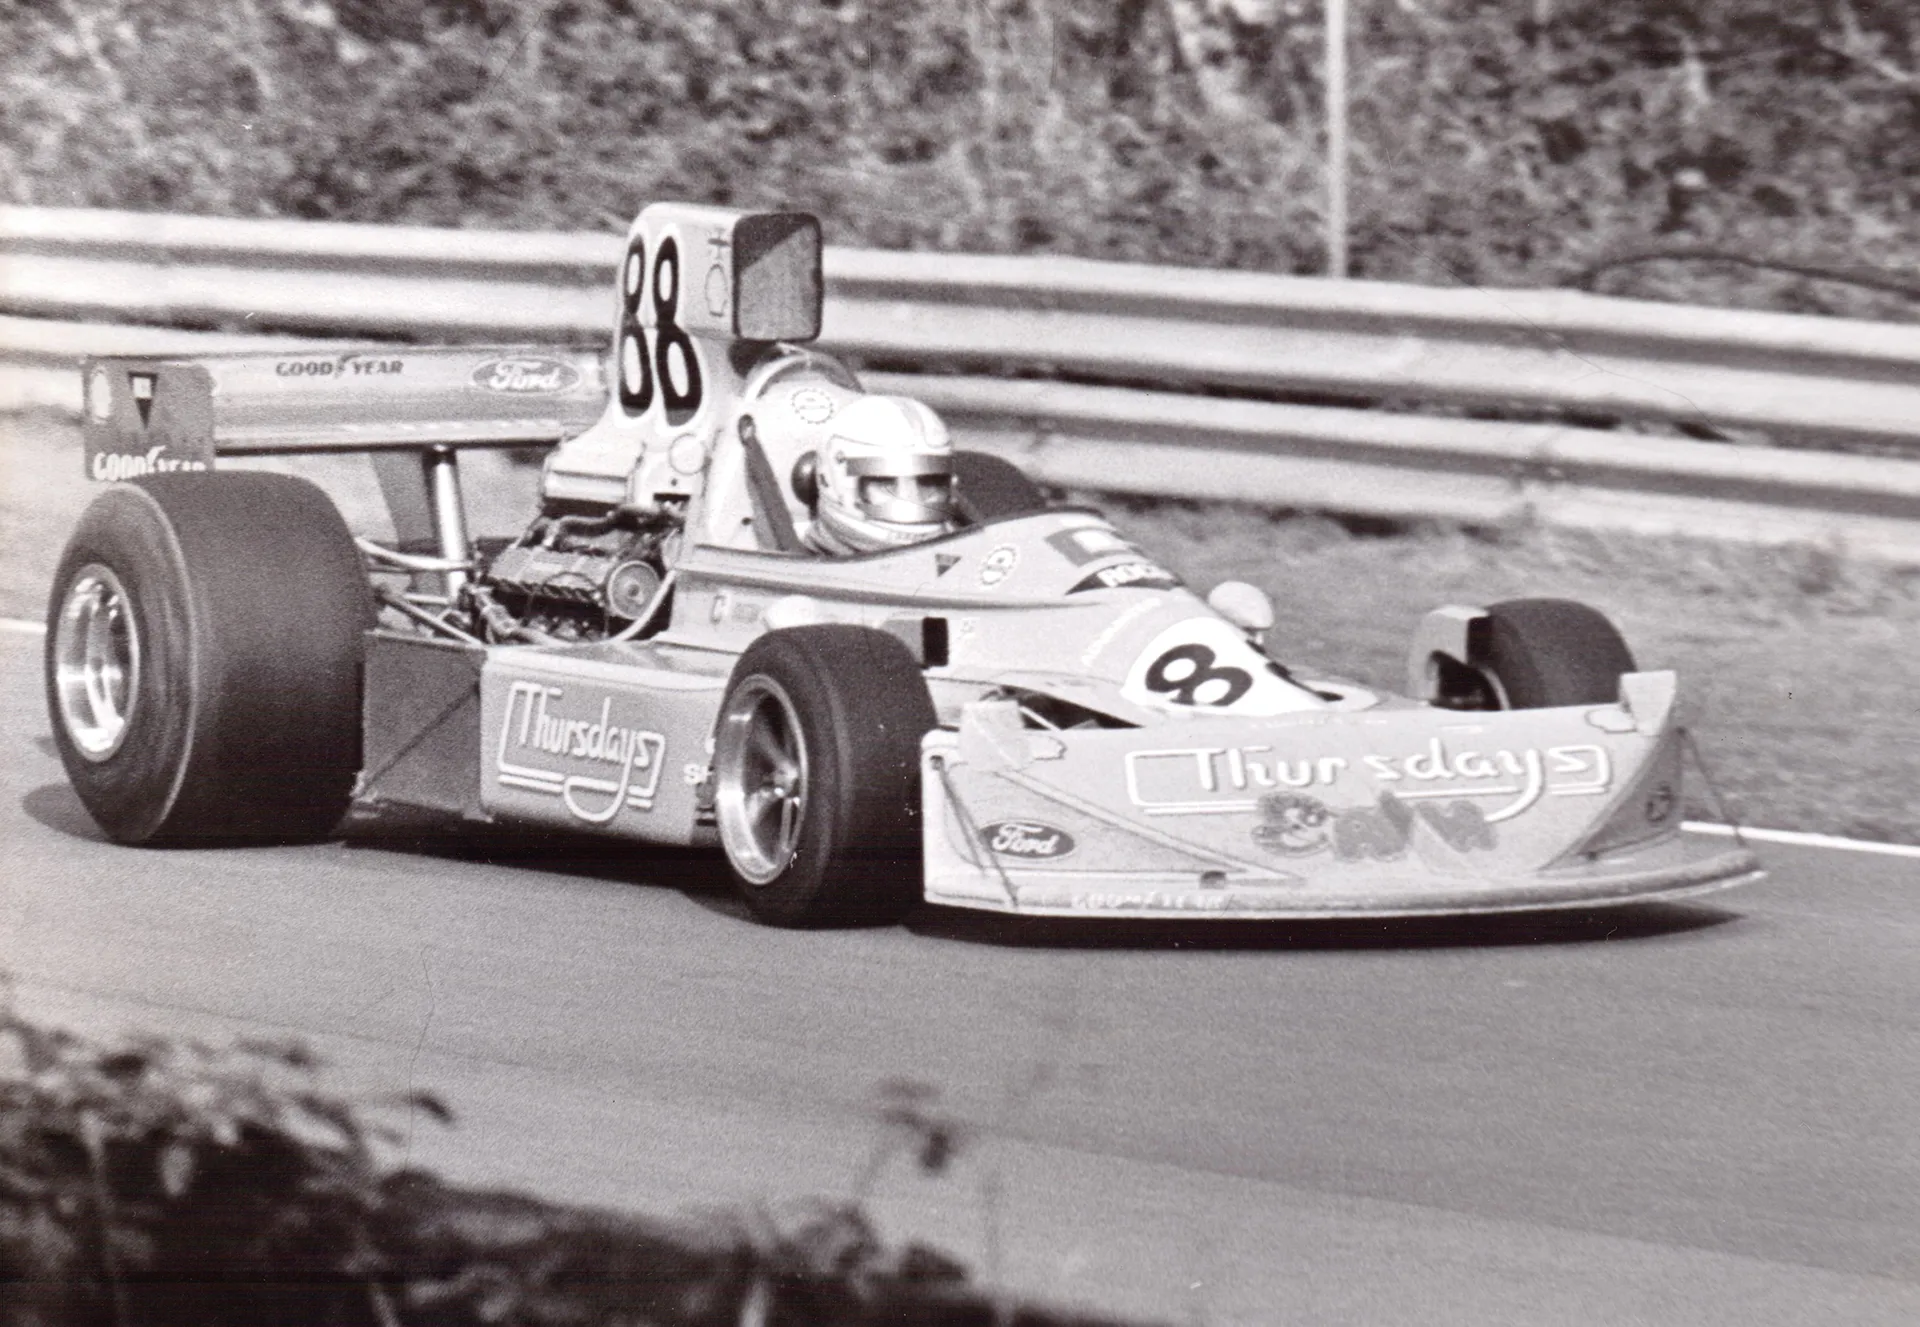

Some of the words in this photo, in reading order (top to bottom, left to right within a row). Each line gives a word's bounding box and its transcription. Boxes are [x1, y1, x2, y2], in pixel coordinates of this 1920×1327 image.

[618, 233, 703, 428] 88
[488, 359, 563, 391] Ford
[508, 682, 656, 822] Thursdays
[1188, 737, 1592, 822] Thursdays
[990, 822, 1061, 855] Ford
